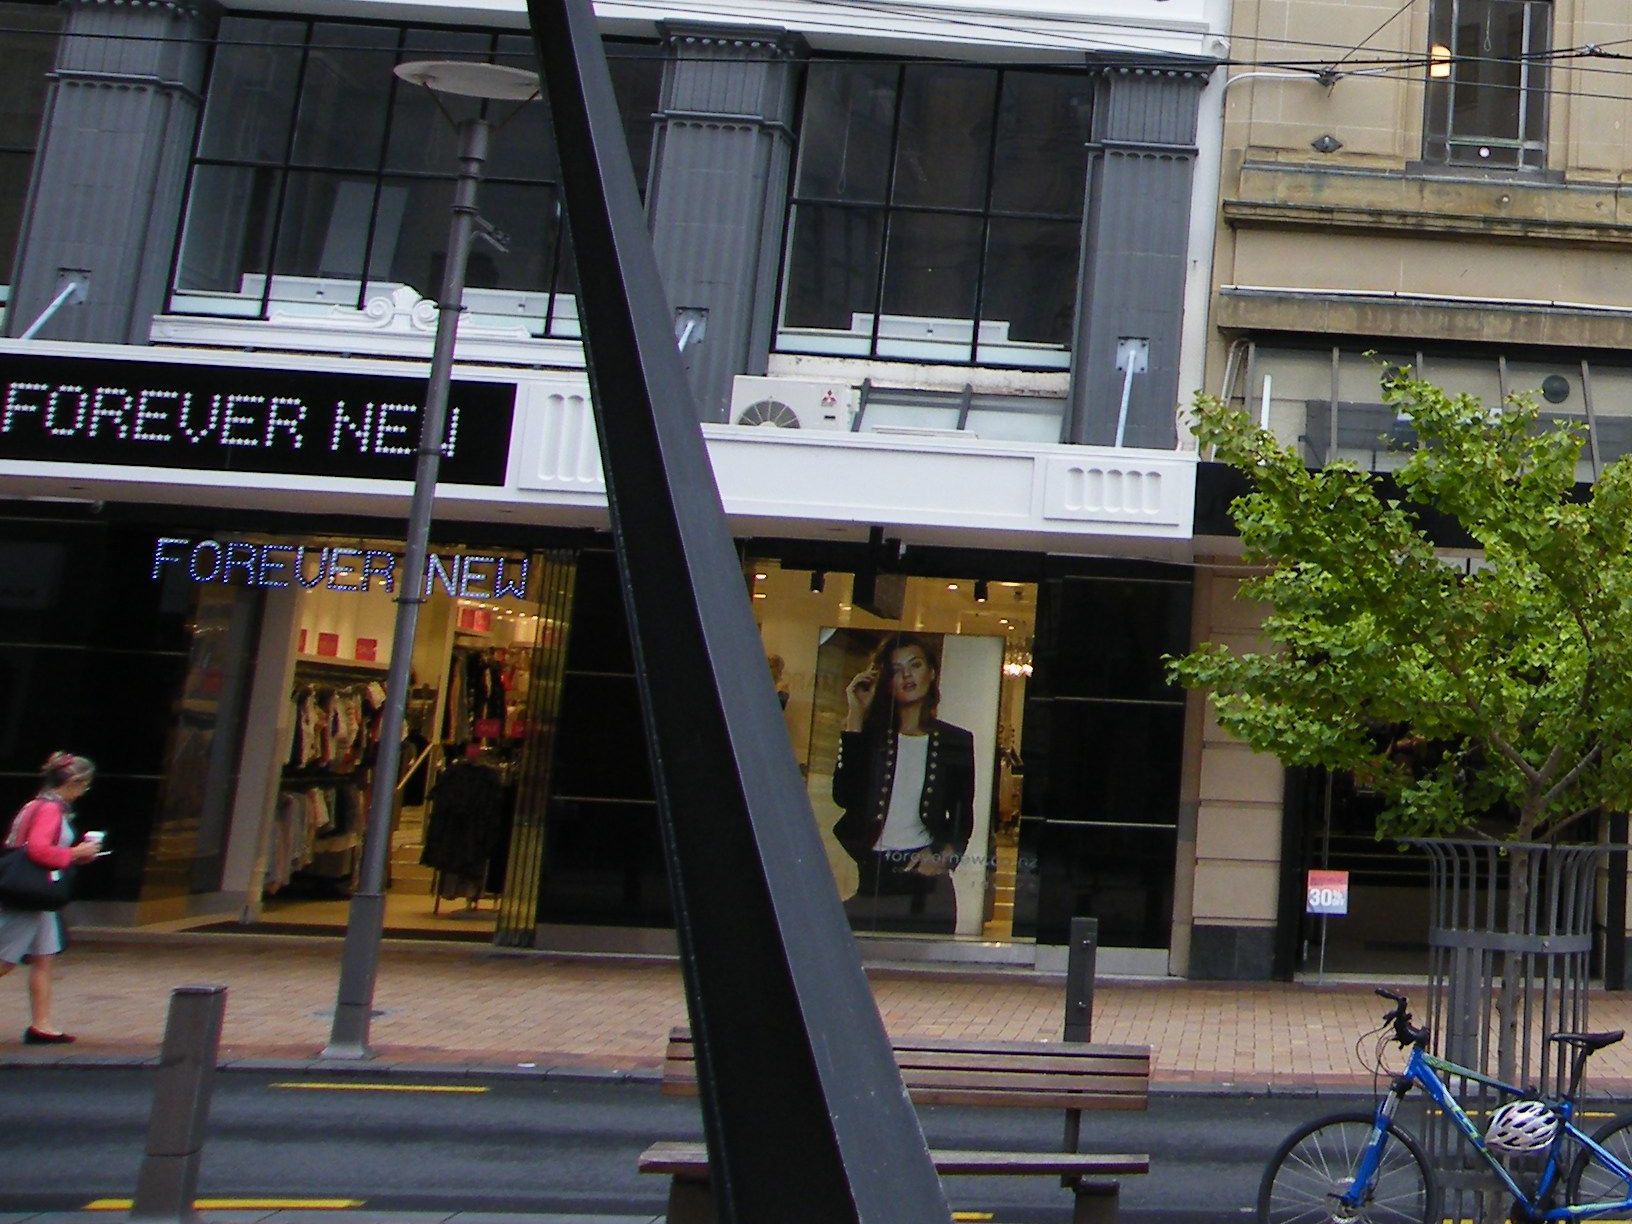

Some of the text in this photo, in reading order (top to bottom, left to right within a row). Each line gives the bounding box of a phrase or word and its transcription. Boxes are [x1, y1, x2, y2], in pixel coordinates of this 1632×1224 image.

[1, 382, 307, 449] FOREVER
[151, 537, 529, 599] FOREVER NEW
